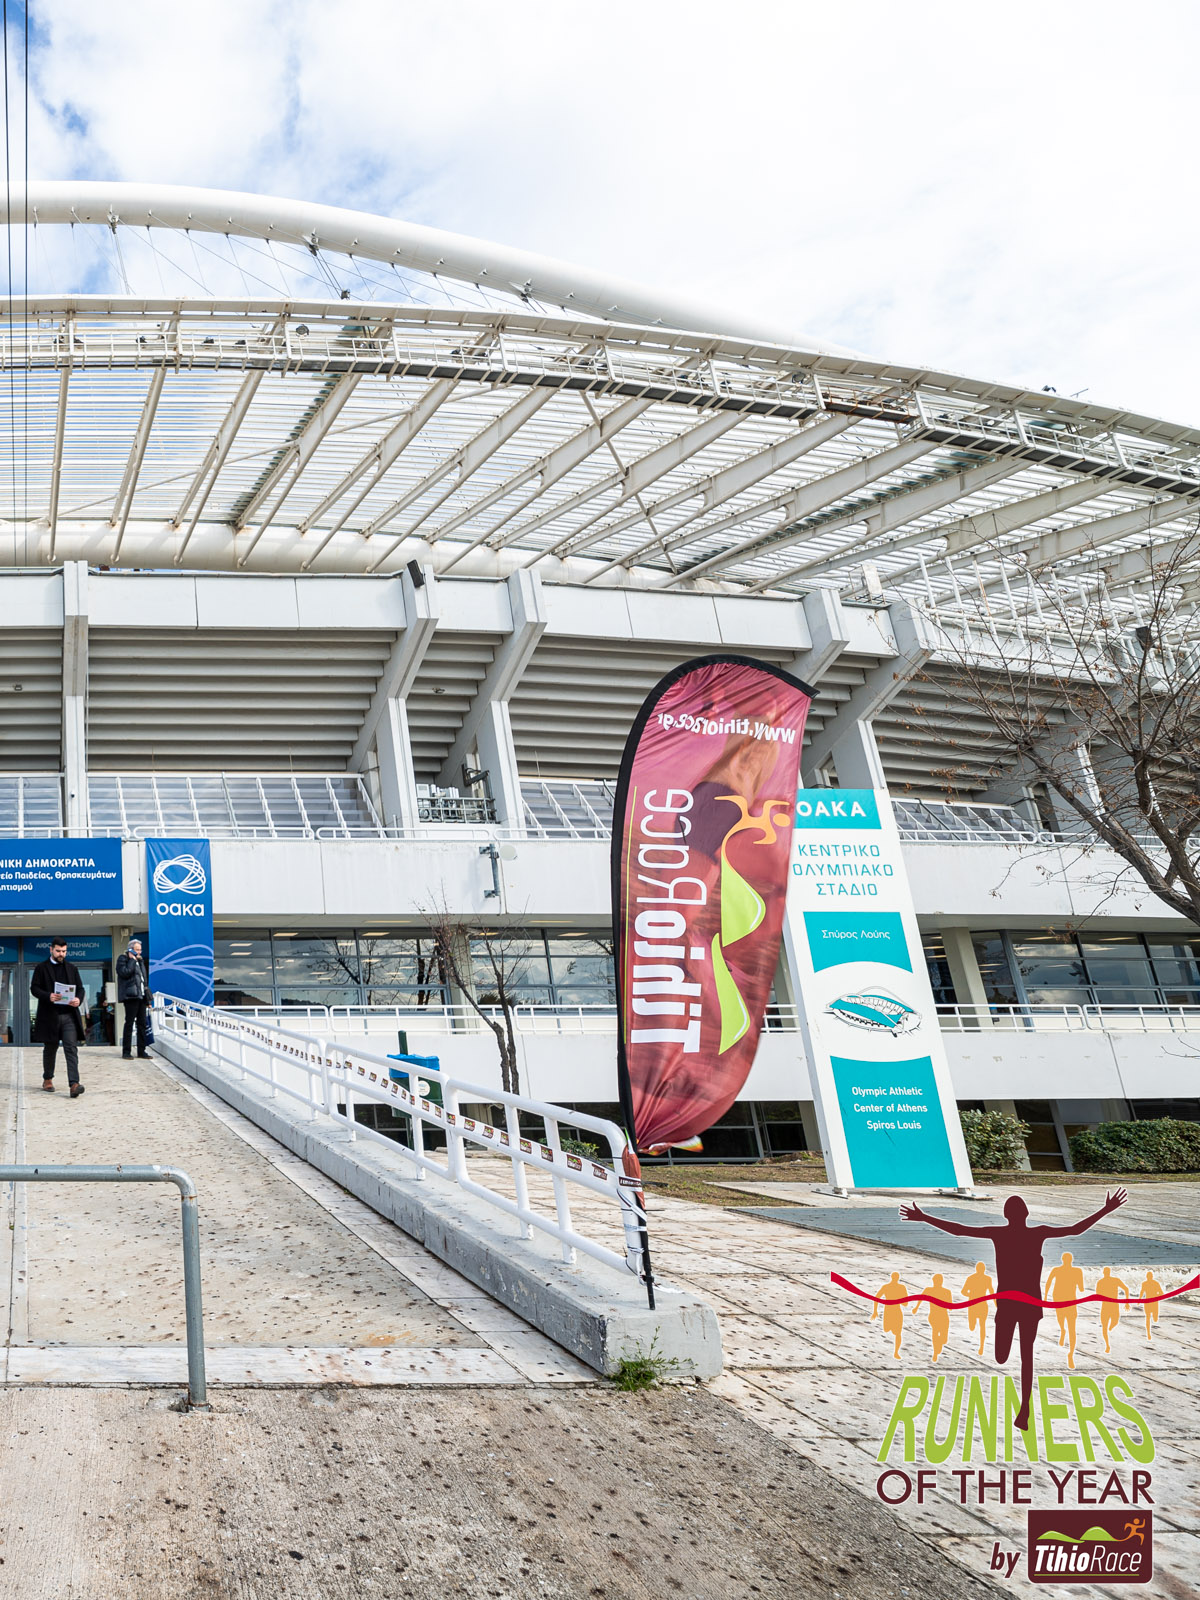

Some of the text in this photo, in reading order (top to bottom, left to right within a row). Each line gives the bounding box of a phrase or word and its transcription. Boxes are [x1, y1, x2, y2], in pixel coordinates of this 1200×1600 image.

[798, 844, 880, 857] ΚΕΝΤΡΙΚΟ
[25, 858, 95, 868] ΔΗΜΟΚΡΑΤΙΑ
[15, 871, 54, 880] Παιδείας,
[55, 870, 117, 880] Θρησκευμάτων
[792, 863, 894, 877] ΟΛΥΜΠΙΑΚΟ
[816, 883, 878, 896] ΣΤΑΔΙΟ
[822, 929, 891, 940] Σπύρος Λούης
[851, 1086, 923, 1098] Olympic Athletic
[853, 1103, 928, 1113] Center of Athens
[866, 1120, 922, 1131] Spiros Louis
